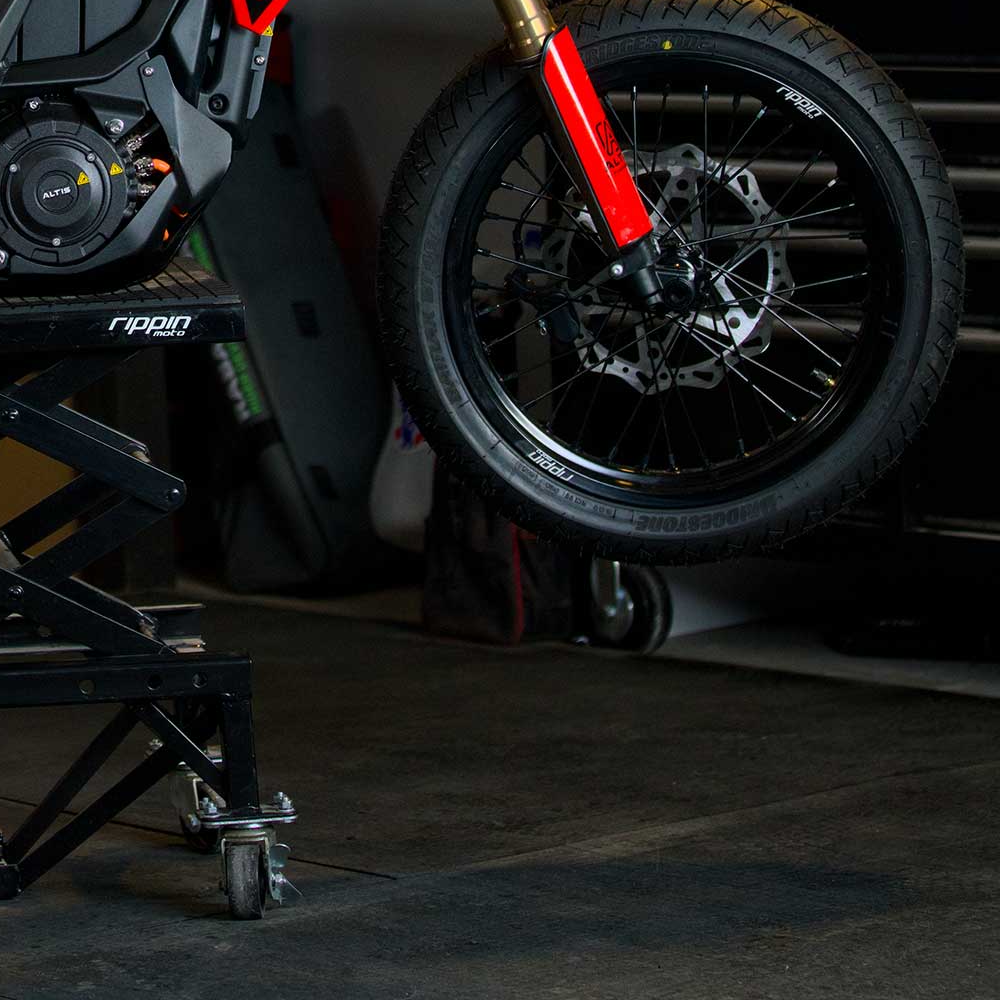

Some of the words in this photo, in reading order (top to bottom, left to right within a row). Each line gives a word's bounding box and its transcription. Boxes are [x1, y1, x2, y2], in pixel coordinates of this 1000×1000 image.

[776, 86, 822, 118] rippin
[43, 186, 71, 200] ALTIS
[107, 316, 192, 335] rippin
[528, 451, 574, 481] rippin
